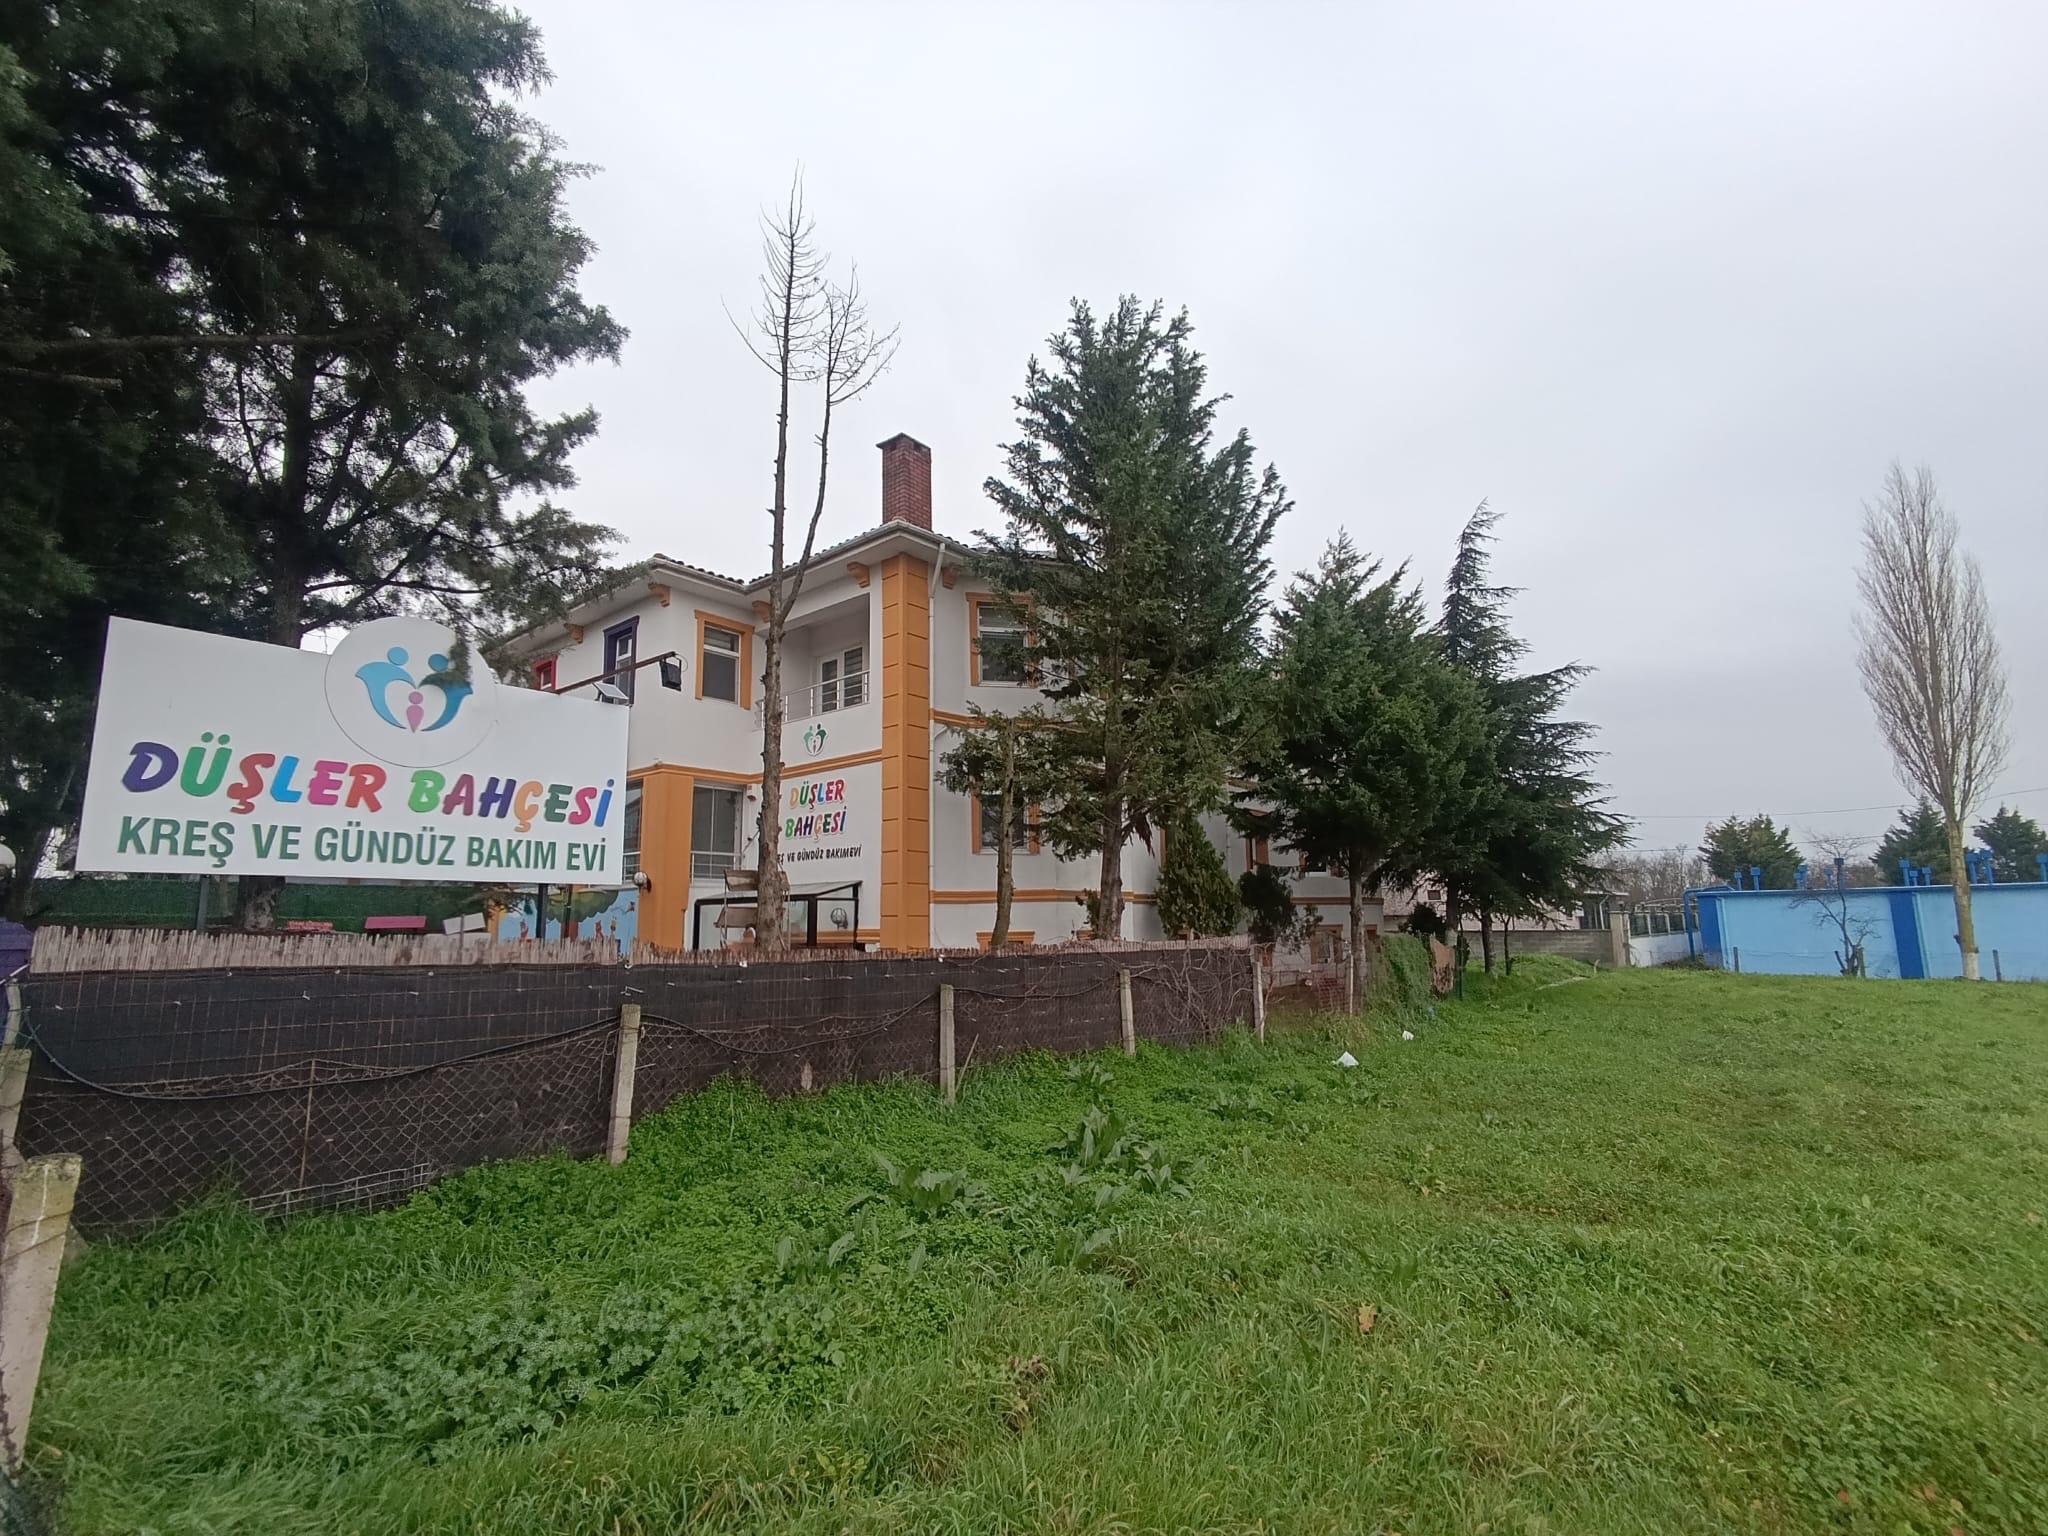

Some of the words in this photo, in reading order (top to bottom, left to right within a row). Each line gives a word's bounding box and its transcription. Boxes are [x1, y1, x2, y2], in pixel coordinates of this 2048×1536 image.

[121, 731, 387, 814] DÜŞLER
[408, 770, 614, 833] BAHÇESİ
[789, 778, 845, 809] DÜŞLER
[785, 806, 847, 841] BAHÇESİ
[117, 816, 235, 868] KREŞ
[252, 823, 302, 860] VE
[314, 821, 456, 866] GÜNDÜZ
[466, 836, 556, 869] BAKIM
[566, 837, 606, 871] EVİ
[787, 850, 795, 862] VE
[797, 847, 824, 861] GÜNDÜZ
